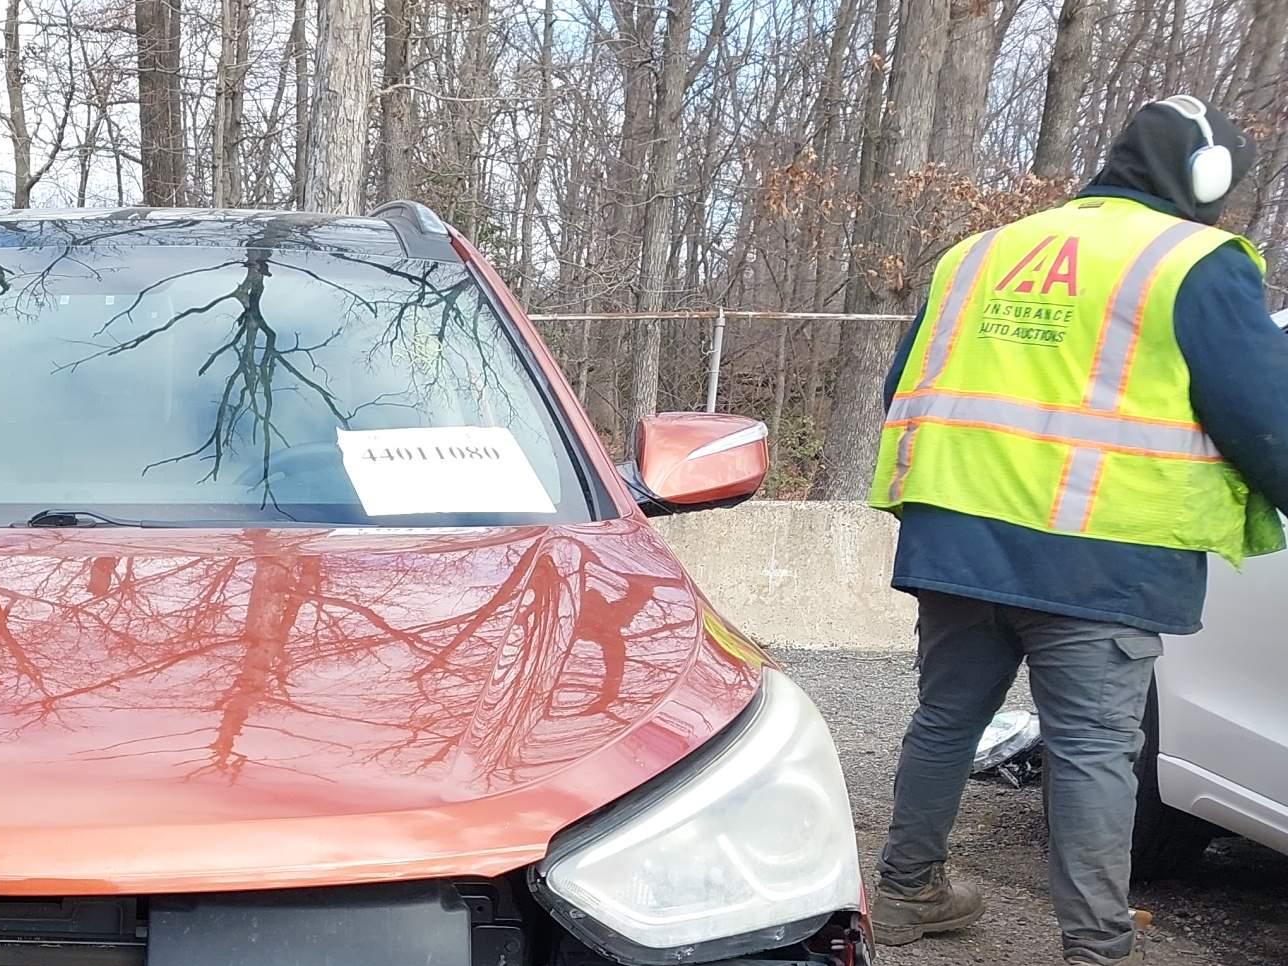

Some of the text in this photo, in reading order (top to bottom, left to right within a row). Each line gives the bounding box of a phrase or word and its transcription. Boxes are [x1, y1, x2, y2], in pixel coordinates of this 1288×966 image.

[983, 303, 1073, 322] INSURANCE
[978, 322, 1066, 343] AUTO AUCTIONS
[361, 446, 500, 461] 44011080
